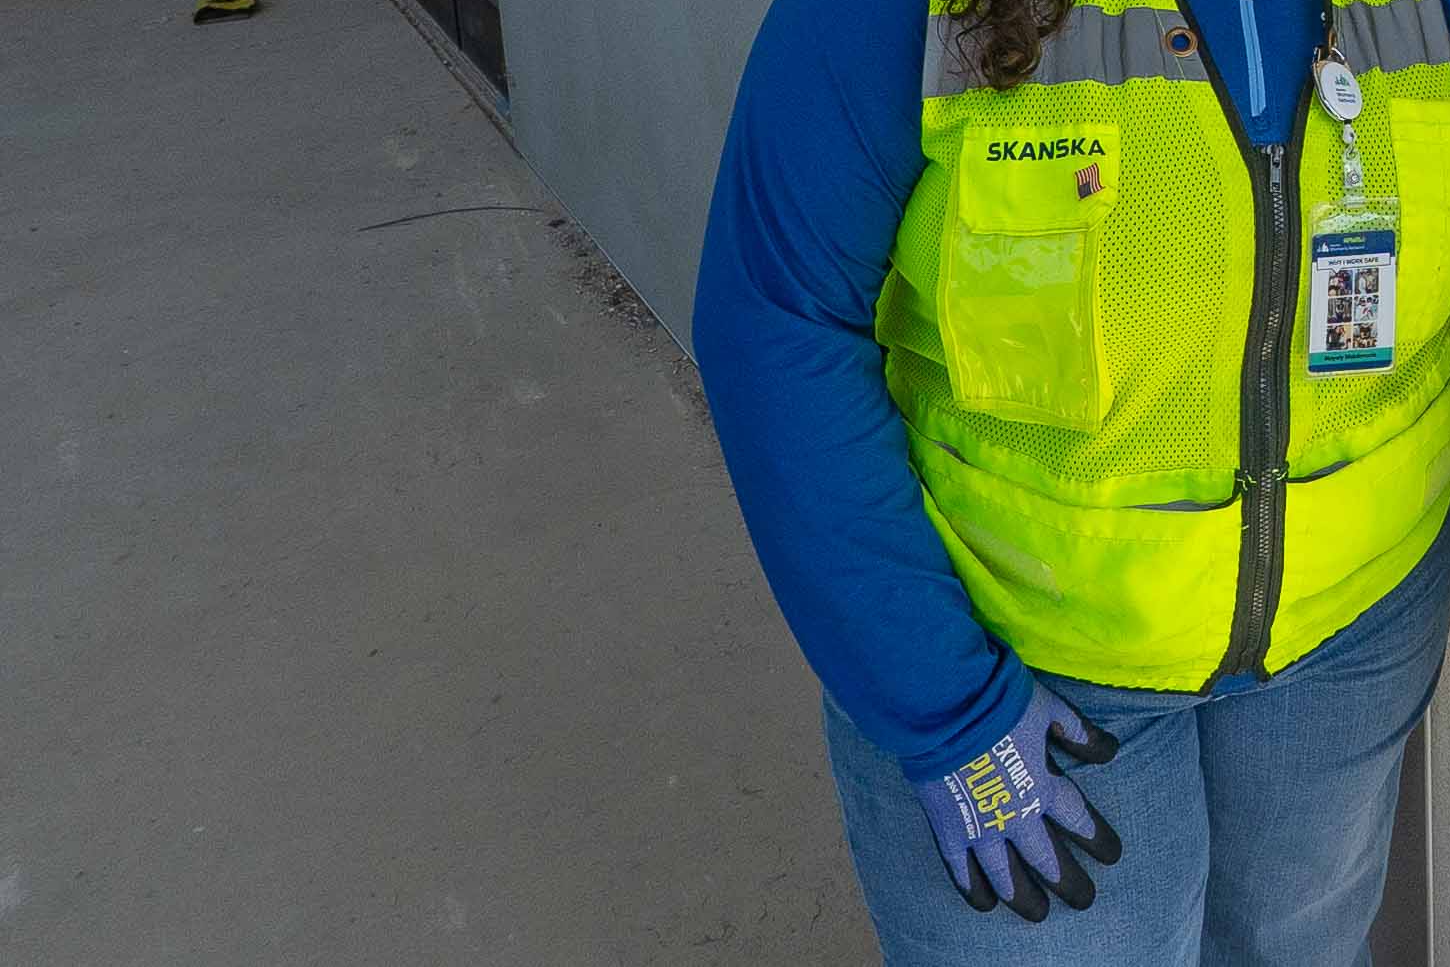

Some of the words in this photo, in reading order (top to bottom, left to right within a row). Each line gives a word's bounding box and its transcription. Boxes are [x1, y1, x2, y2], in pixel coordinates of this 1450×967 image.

[986, 138, 1106, 162] SKANSKA
[1364, 256, 1380, 264] SAFE
[960, 752, 1017, 832] PLUS+
